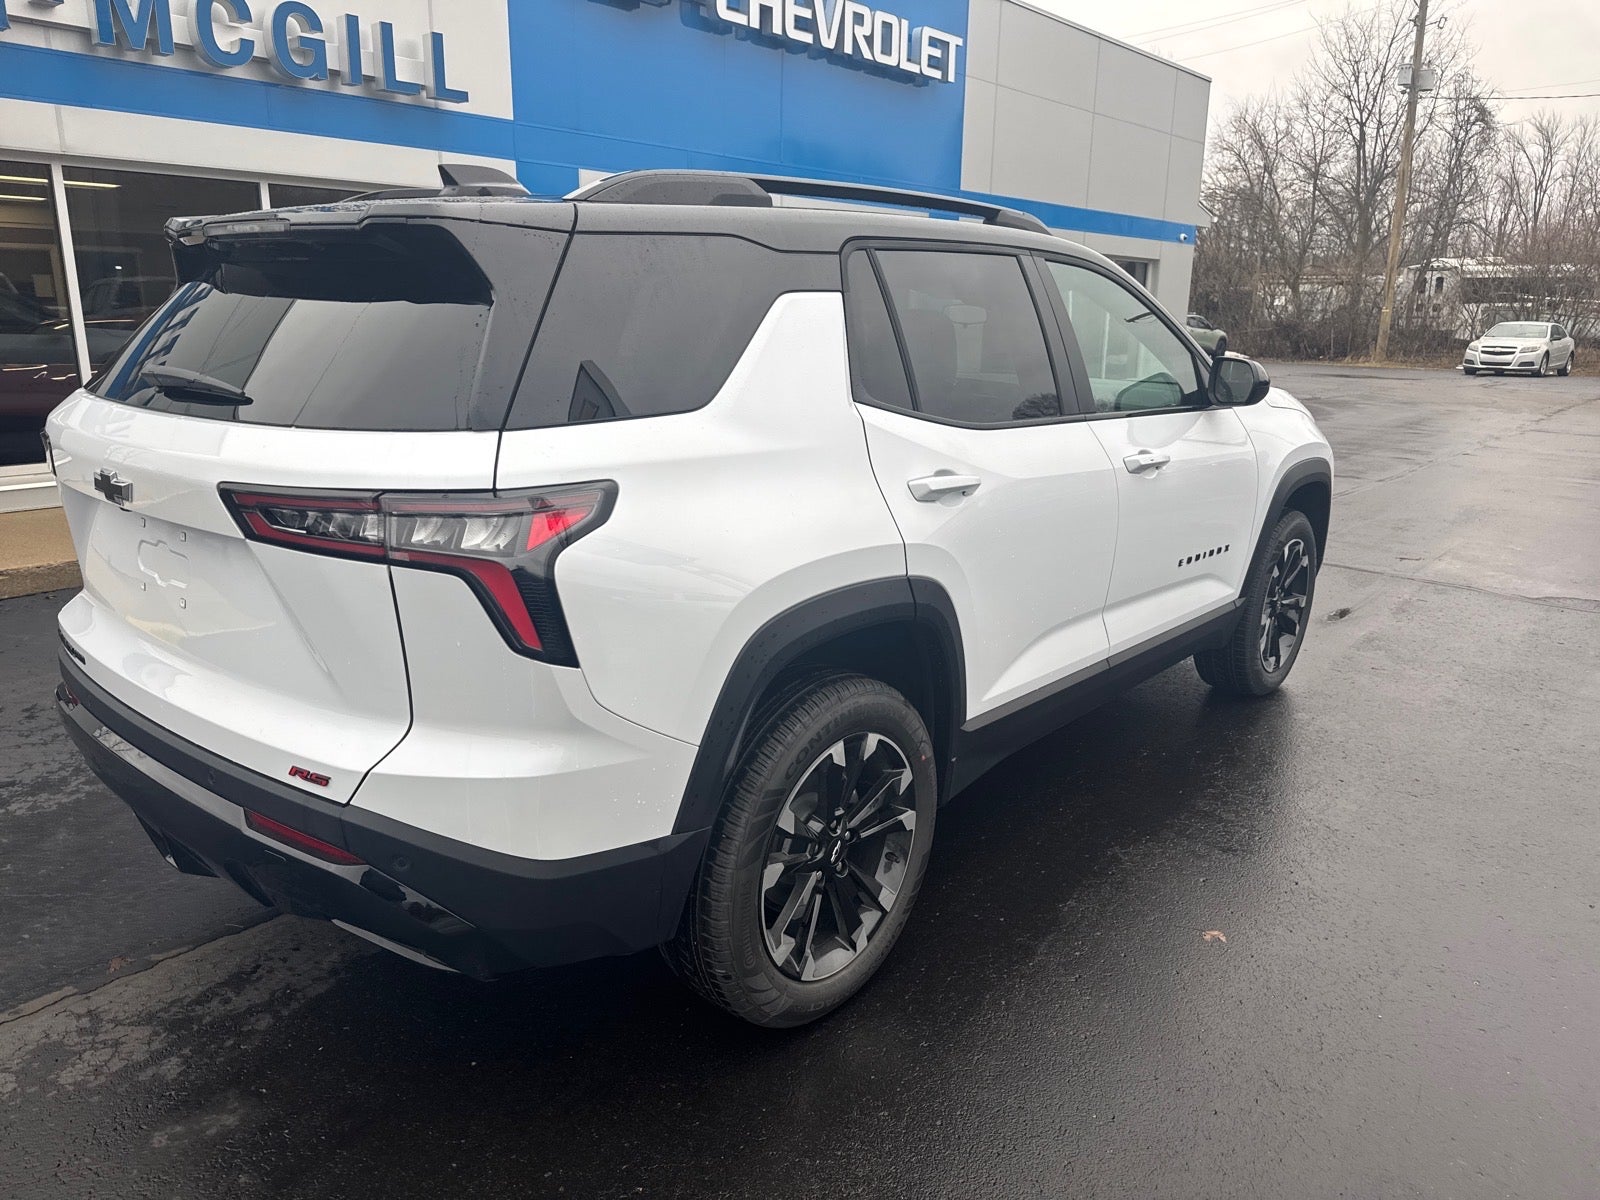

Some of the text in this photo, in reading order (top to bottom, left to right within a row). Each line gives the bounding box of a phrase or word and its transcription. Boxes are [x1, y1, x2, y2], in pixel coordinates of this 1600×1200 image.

[92, 0, 469, 103] MCGILL
[1177, 543, 1231, 568] EQUINOX
[288, 765, 332, 787] RS
